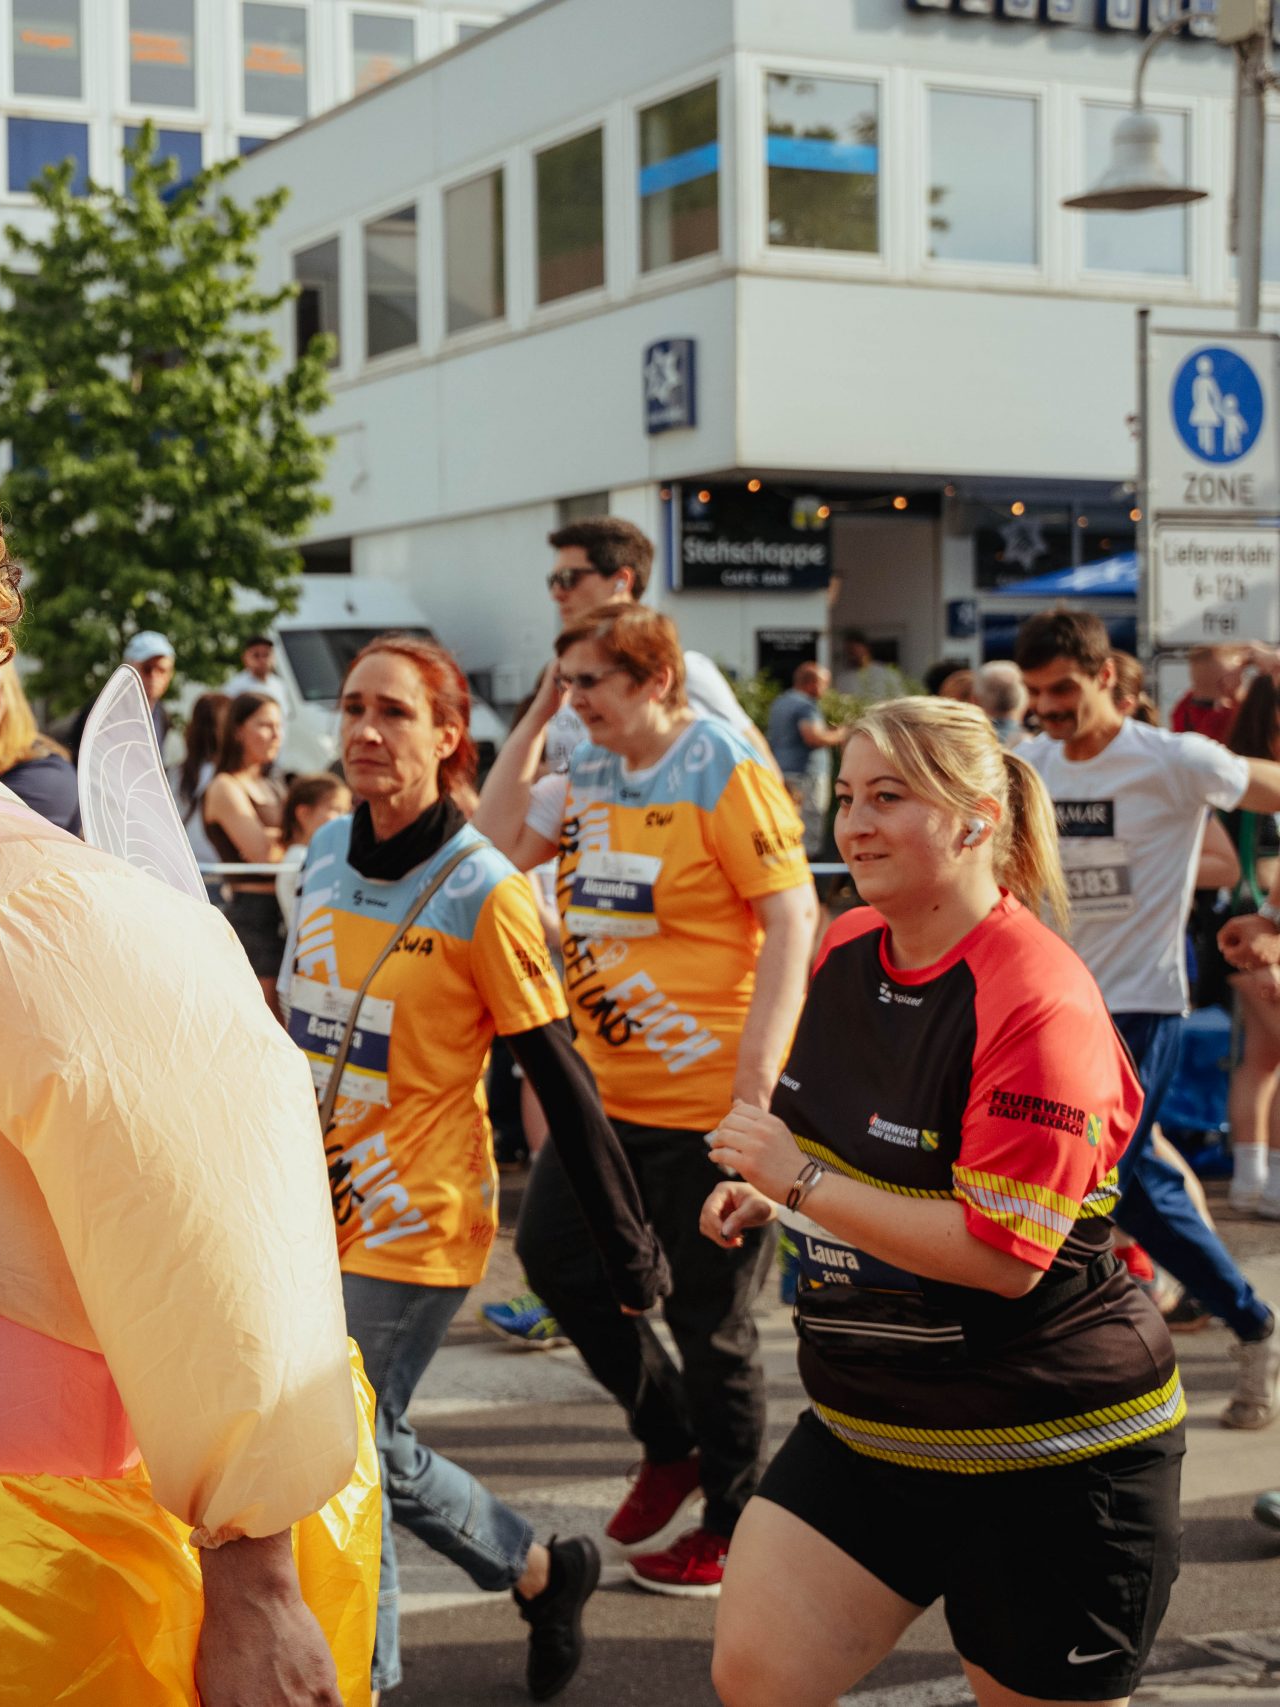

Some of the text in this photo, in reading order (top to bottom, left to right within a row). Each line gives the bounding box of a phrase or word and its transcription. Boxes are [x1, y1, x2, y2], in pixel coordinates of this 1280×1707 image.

[1183, 472, 1255, 506] ZONE
[1163, 539, 1273, 567] Lieferverkehr
[1202, 611, 1239, 635] frei
[581, 879, 638, 900] Alexandra
[987, 1105, 1083, 1138] STADT BEXBACH
[991, 1090, 1086, 1125] FEUERWEHR
[882, 1131, 918, 1149] BEXBACH
[805, 1236, 861, 1271] Laura
